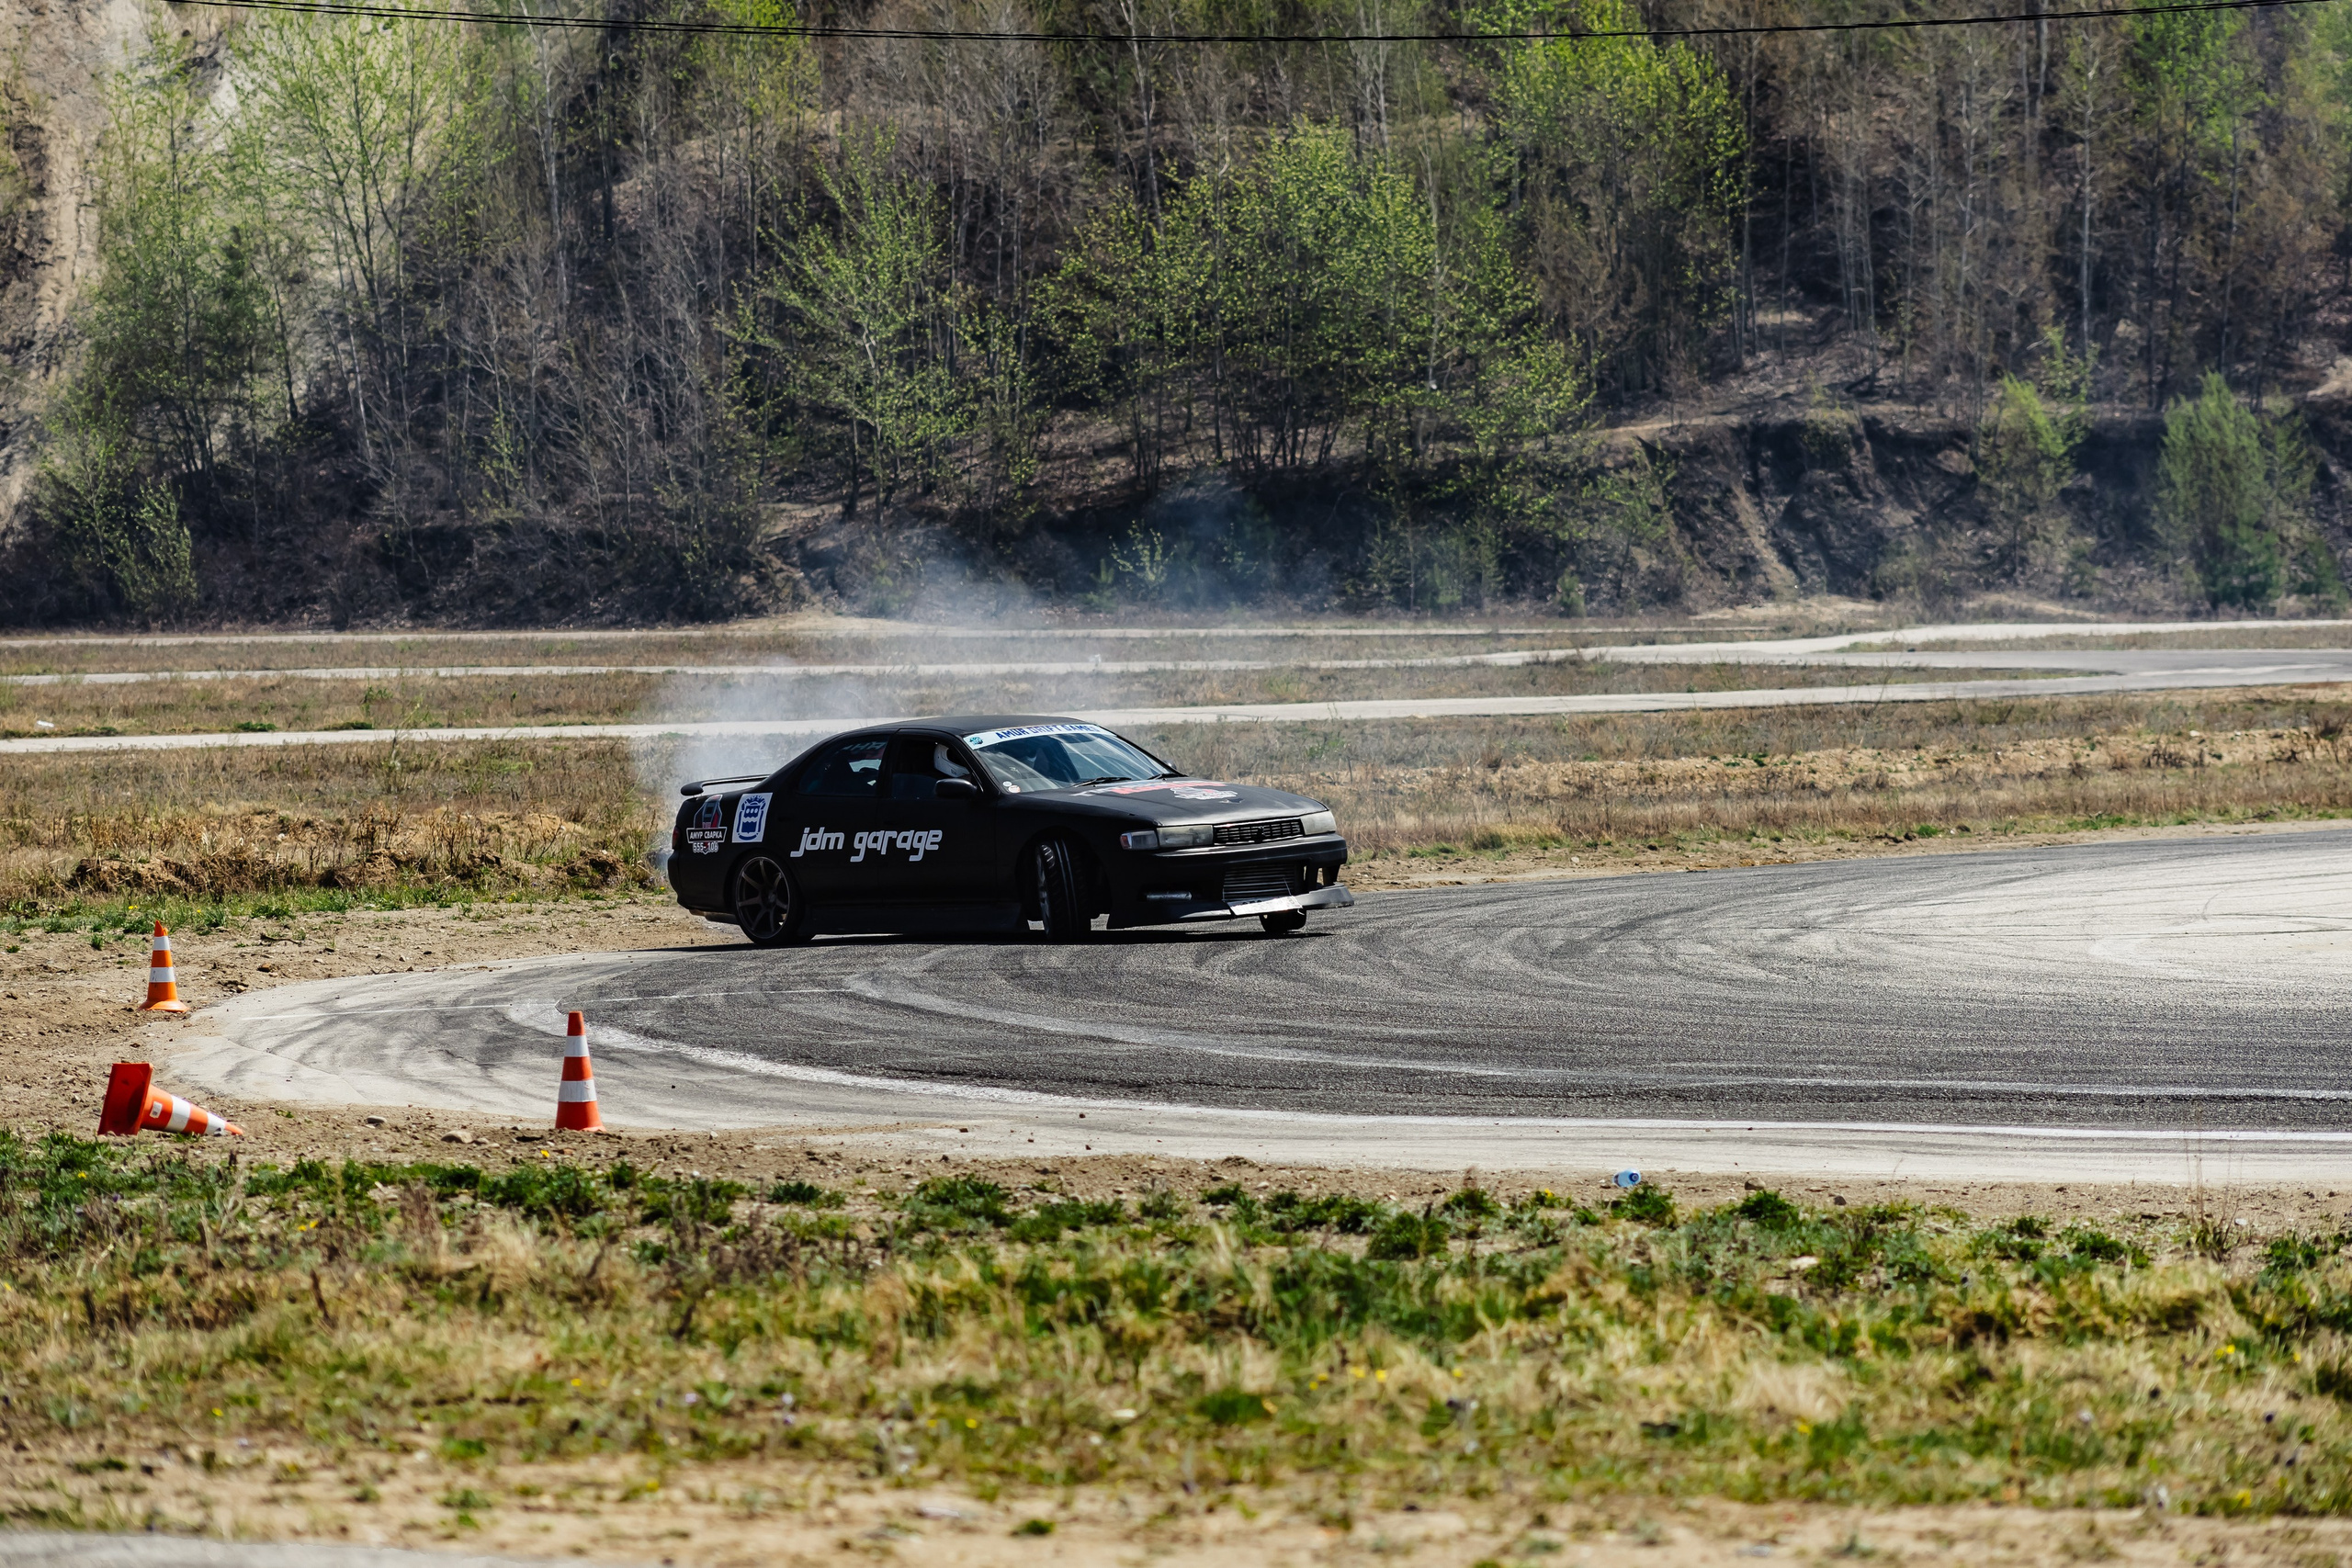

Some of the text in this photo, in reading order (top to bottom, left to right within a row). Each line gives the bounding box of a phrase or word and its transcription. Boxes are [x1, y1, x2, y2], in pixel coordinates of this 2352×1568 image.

[995, 728, 1030, 739] AMUR
[1028, 725, 1062, 734] DRIFT
[790, 827, 943, 863] jdm garage
